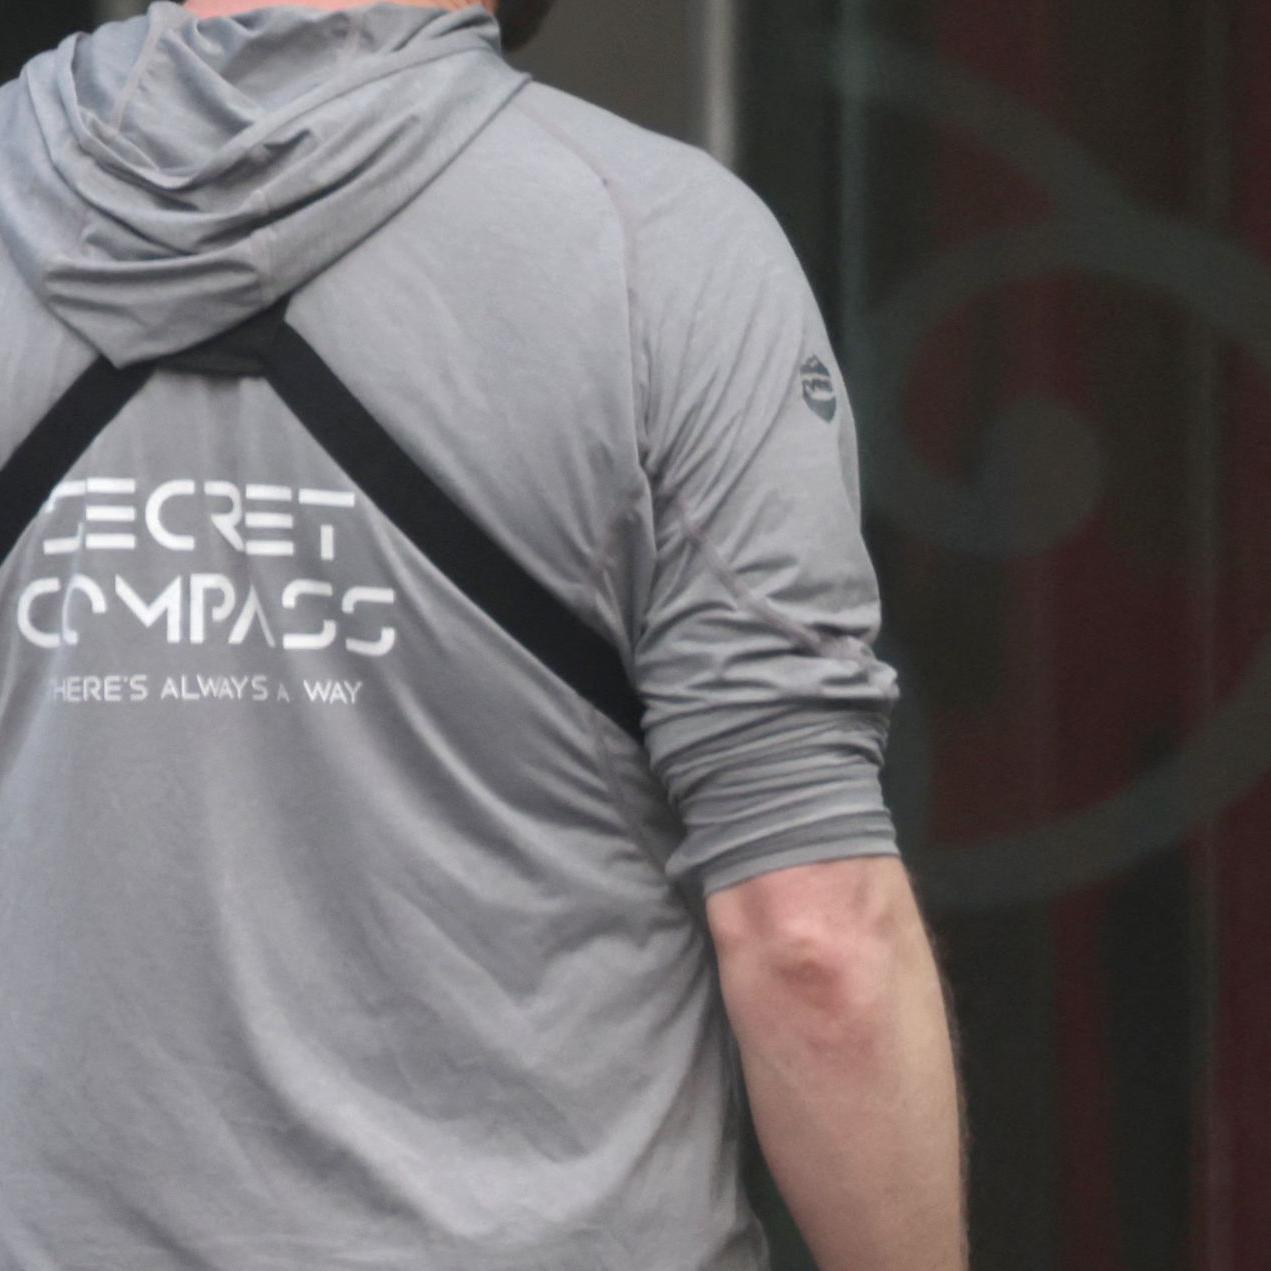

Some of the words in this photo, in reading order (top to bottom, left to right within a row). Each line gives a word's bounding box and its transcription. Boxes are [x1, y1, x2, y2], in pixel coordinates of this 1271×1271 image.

[42, 477, 356, 562] SECRET
[17, 573, 396, 657] COMPASS
[53, 674, 149, 703] HERE'S
[160, 674, 269, 702] ALWAYS
[276, 682, 290, 703] A
[303, 679, 363, 704] WAY
